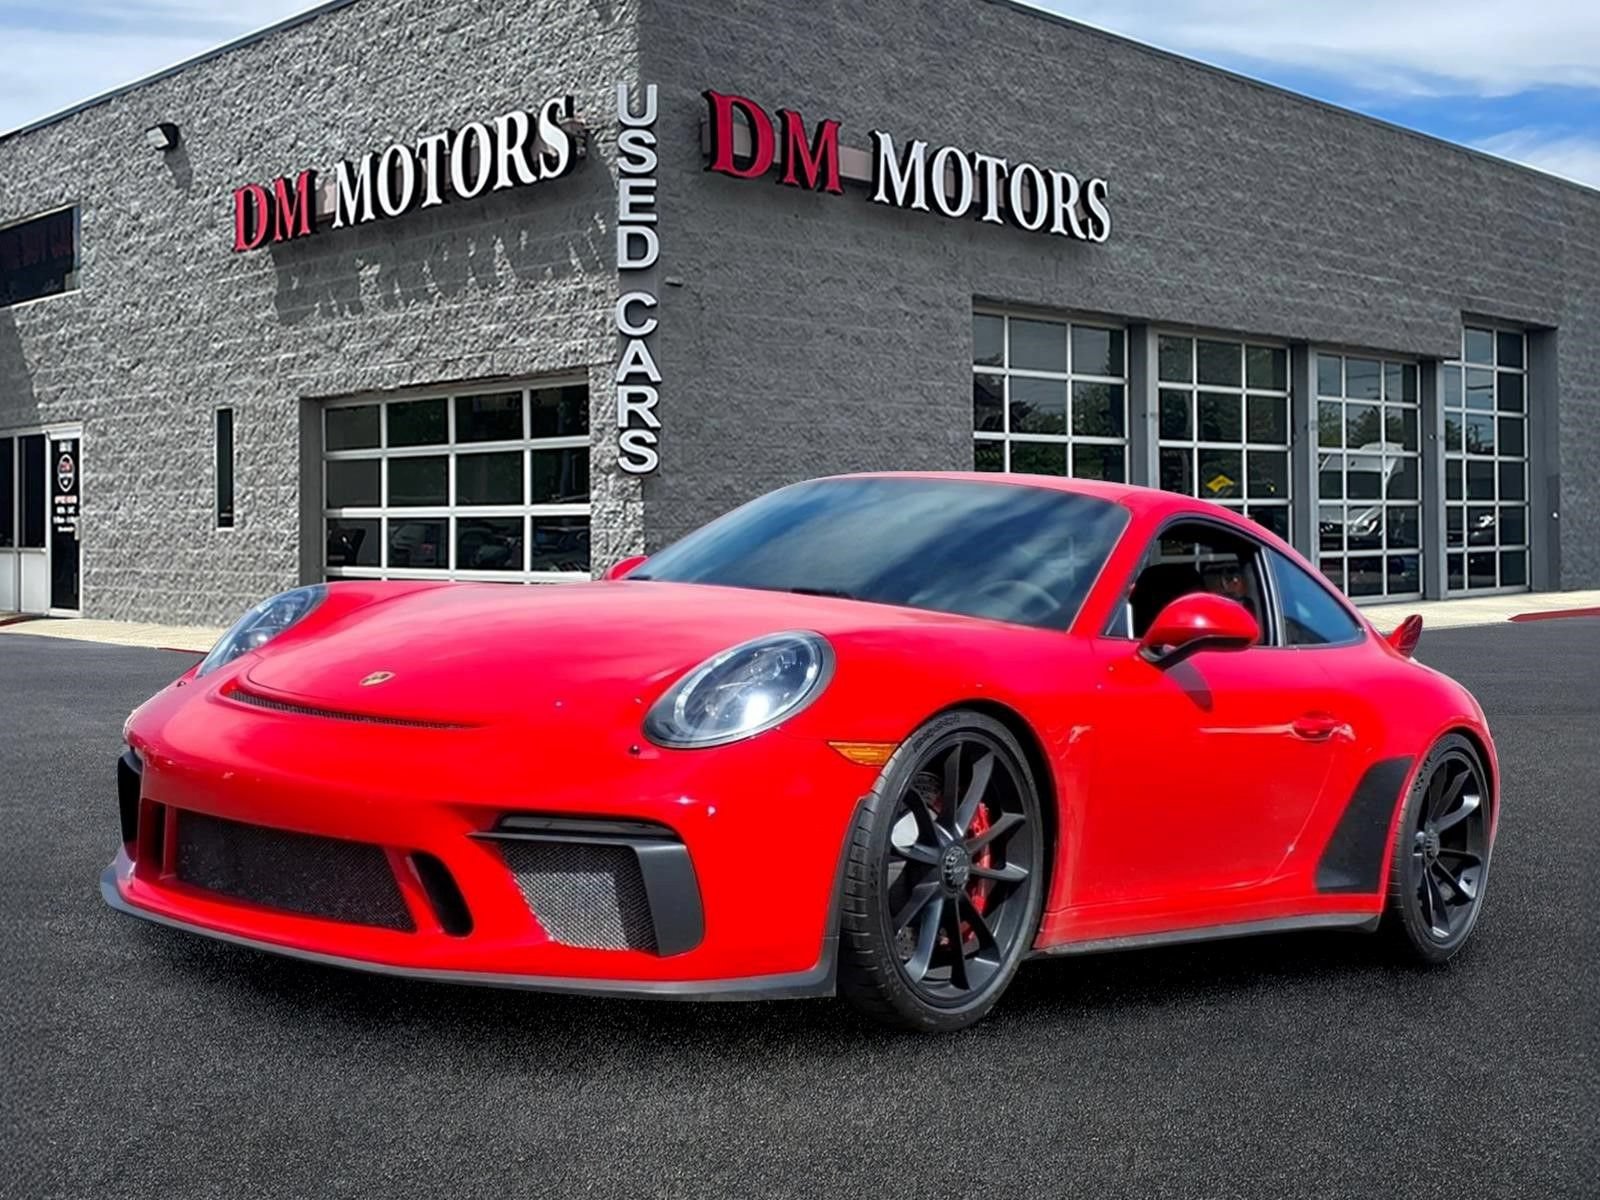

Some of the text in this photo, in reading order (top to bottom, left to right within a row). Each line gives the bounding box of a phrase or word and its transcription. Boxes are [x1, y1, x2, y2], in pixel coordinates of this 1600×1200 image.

[233, 96, 572, 252] DM MOTORS
[704, 90, 1111, 244] DM MOTORS
[615, 83, 663, 473] USED CARS
